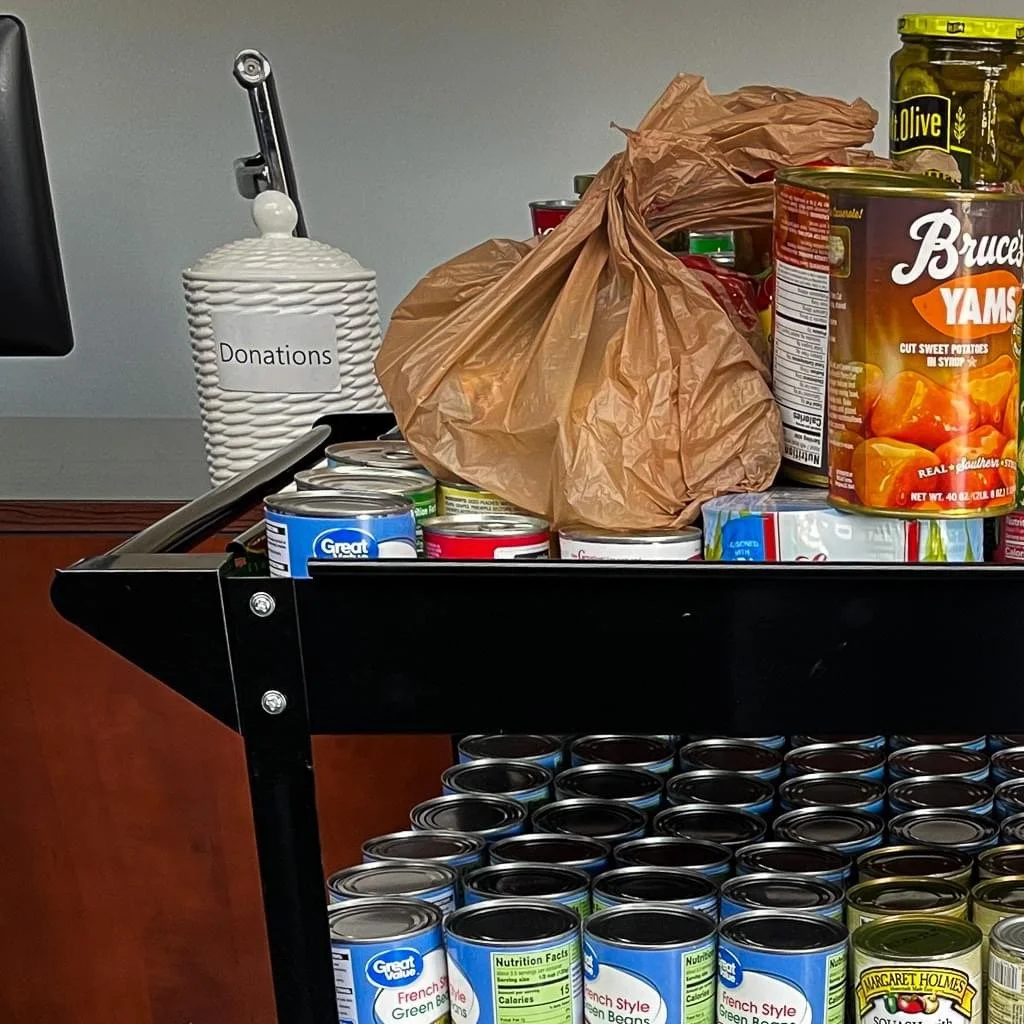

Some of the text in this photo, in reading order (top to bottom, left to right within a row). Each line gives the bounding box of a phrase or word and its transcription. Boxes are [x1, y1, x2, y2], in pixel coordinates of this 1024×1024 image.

[900, 104, 942, 142] Olive
[891, 208, 1024, 285] Bruce's
[939, 285, 1018, 325] YAMS
[219, 342, 332, 367] Donations
[900, 343, 989, 355] CUT SWEET POTATOES
[938, 357, 965, 368] SYRUP
[917, 464, 948, 479] REAL
[910, 491, 927, 501] NET
[946, 491, 957, 501] 40
[320, 538, 368, 554] Great
[373, 956, 415, 973] Great
[496, 949, 569, 967] Nutrition Facts
[384, 968, 416, 981] Value
[863, 972, 967, 993] MARGARET HOLMES
[397, 981, 439, 1005] French
[498, 983, 570, 1005] Calories 15
[391, 1001, 434, 1020] Green
[616, 999, 650, 1015] Style
[722, 991, 796, 1019] French Style
